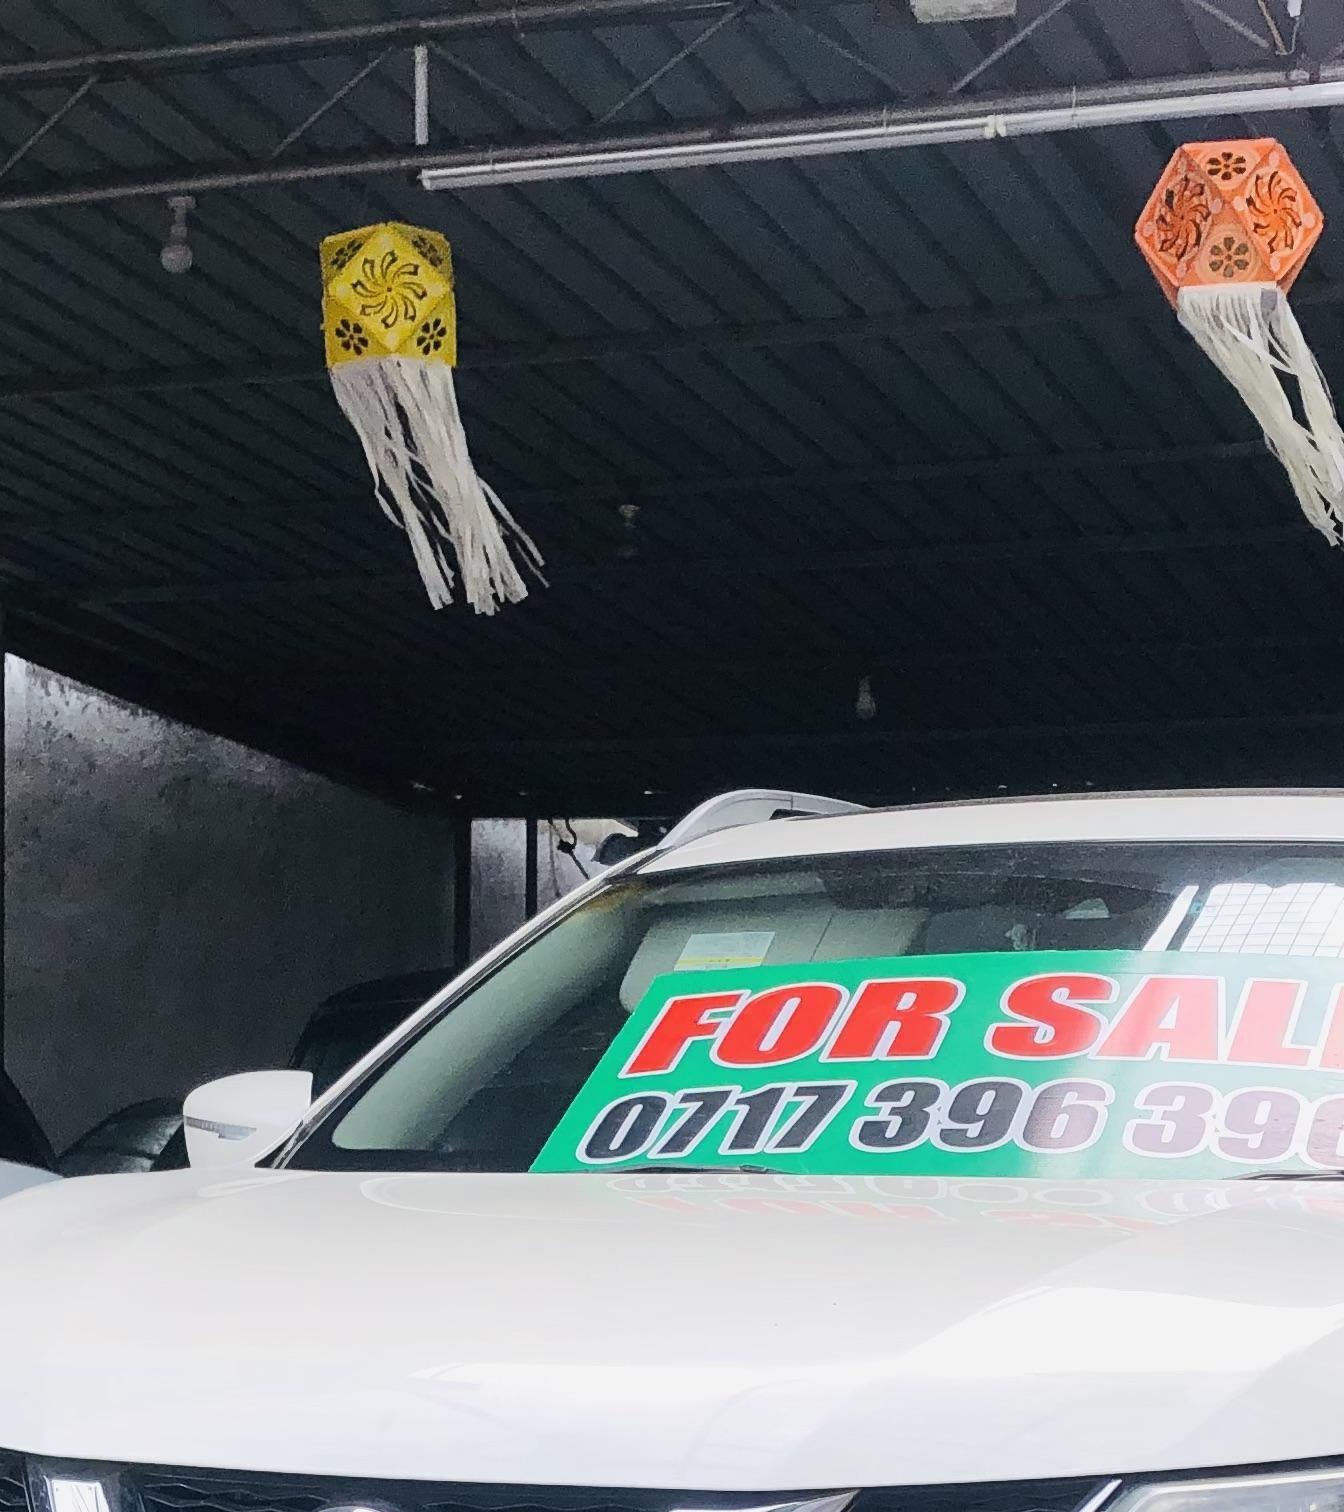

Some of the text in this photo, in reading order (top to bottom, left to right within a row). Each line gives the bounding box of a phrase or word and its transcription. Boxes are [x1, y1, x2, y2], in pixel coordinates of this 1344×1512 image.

[619, 976, 965, 1078] FOR
[576, 1081, 857, 1164] 0717
[850, 1077, 1112, 1157] 396
